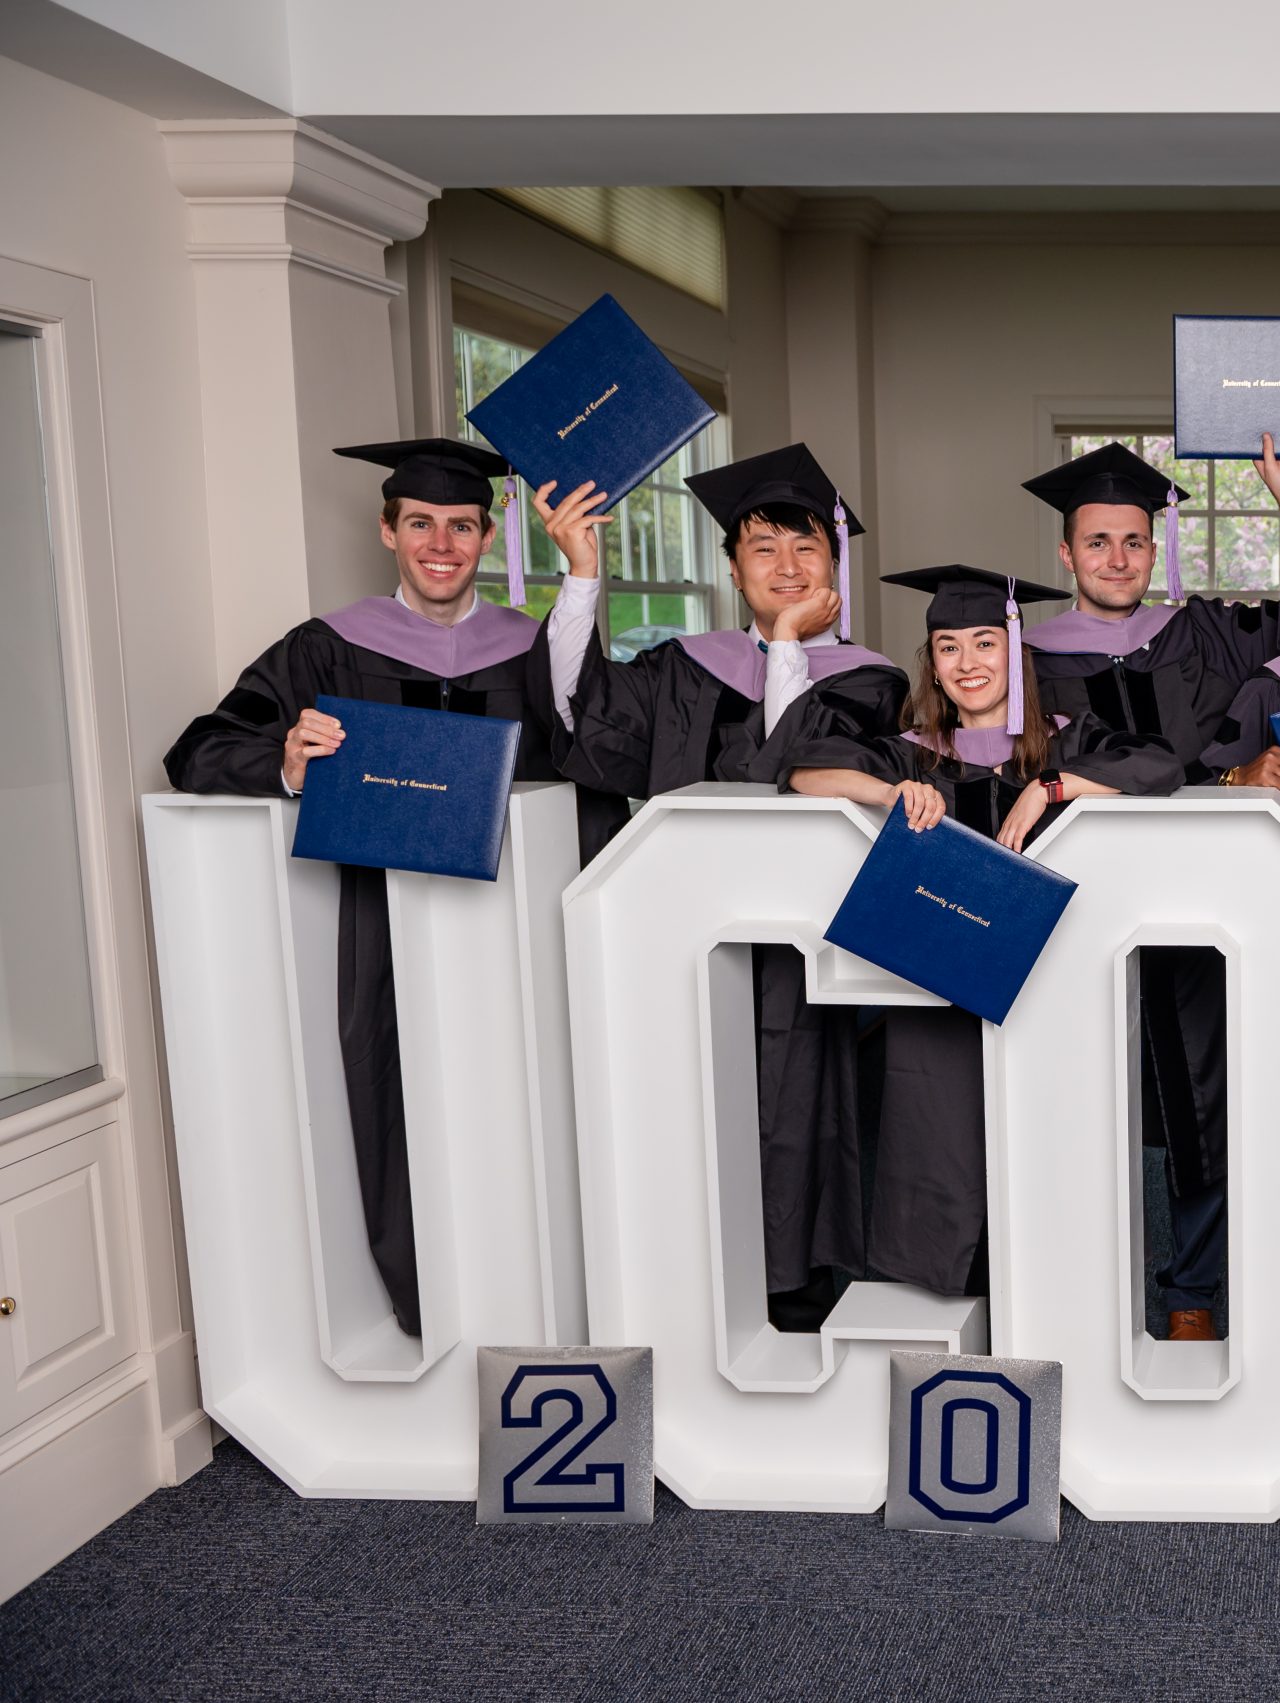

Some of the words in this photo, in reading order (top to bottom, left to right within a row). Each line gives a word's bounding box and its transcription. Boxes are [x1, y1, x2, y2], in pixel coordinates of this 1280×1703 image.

[1222, 379, 1251, 388] University
[557, 415, 586, 439] University
[590, 383, 619, 410] Connecticut
[362, 773, 398, 787] University
[409, 779, 447, 791] Connecticut
[915, 885, 947, 907] University
[957, 906, 990, 927] Connecticut
